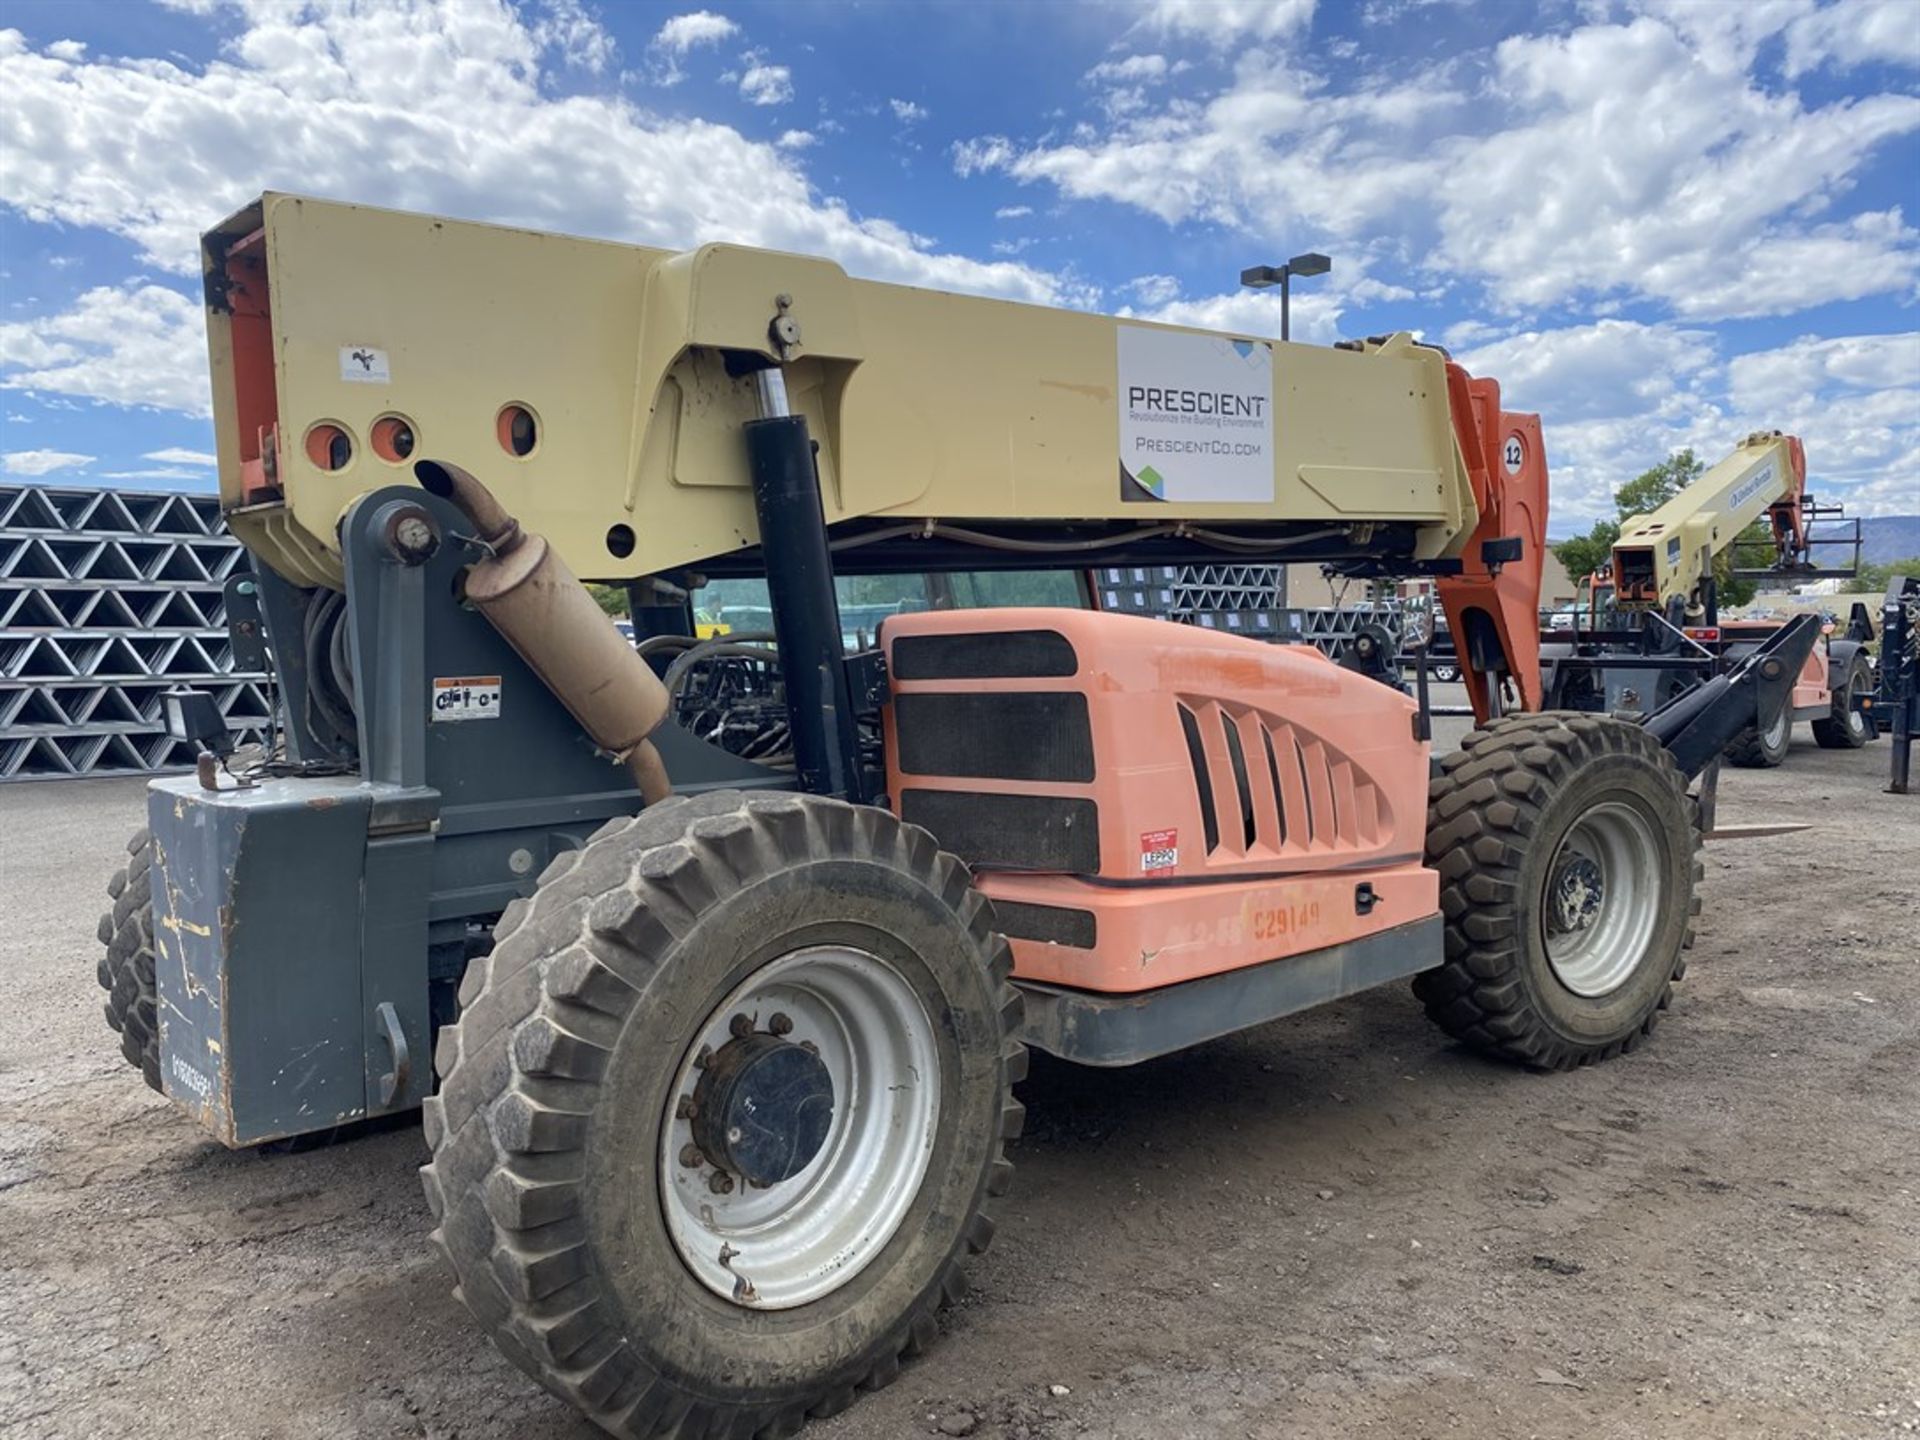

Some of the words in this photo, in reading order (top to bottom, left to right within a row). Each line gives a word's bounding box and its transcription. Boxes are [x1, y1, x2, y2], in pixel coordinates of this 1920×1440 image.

[1129, 386, 1265, 418] PRESCIENT
[1180, 413, 1192, 424] the
[1193, 414, 1221, 429] Building
[1222, 416, 1264, 429] Environment
[1506, 445, 1521, 465] 12
[1144, 849, 1175, 864] LEPPO
